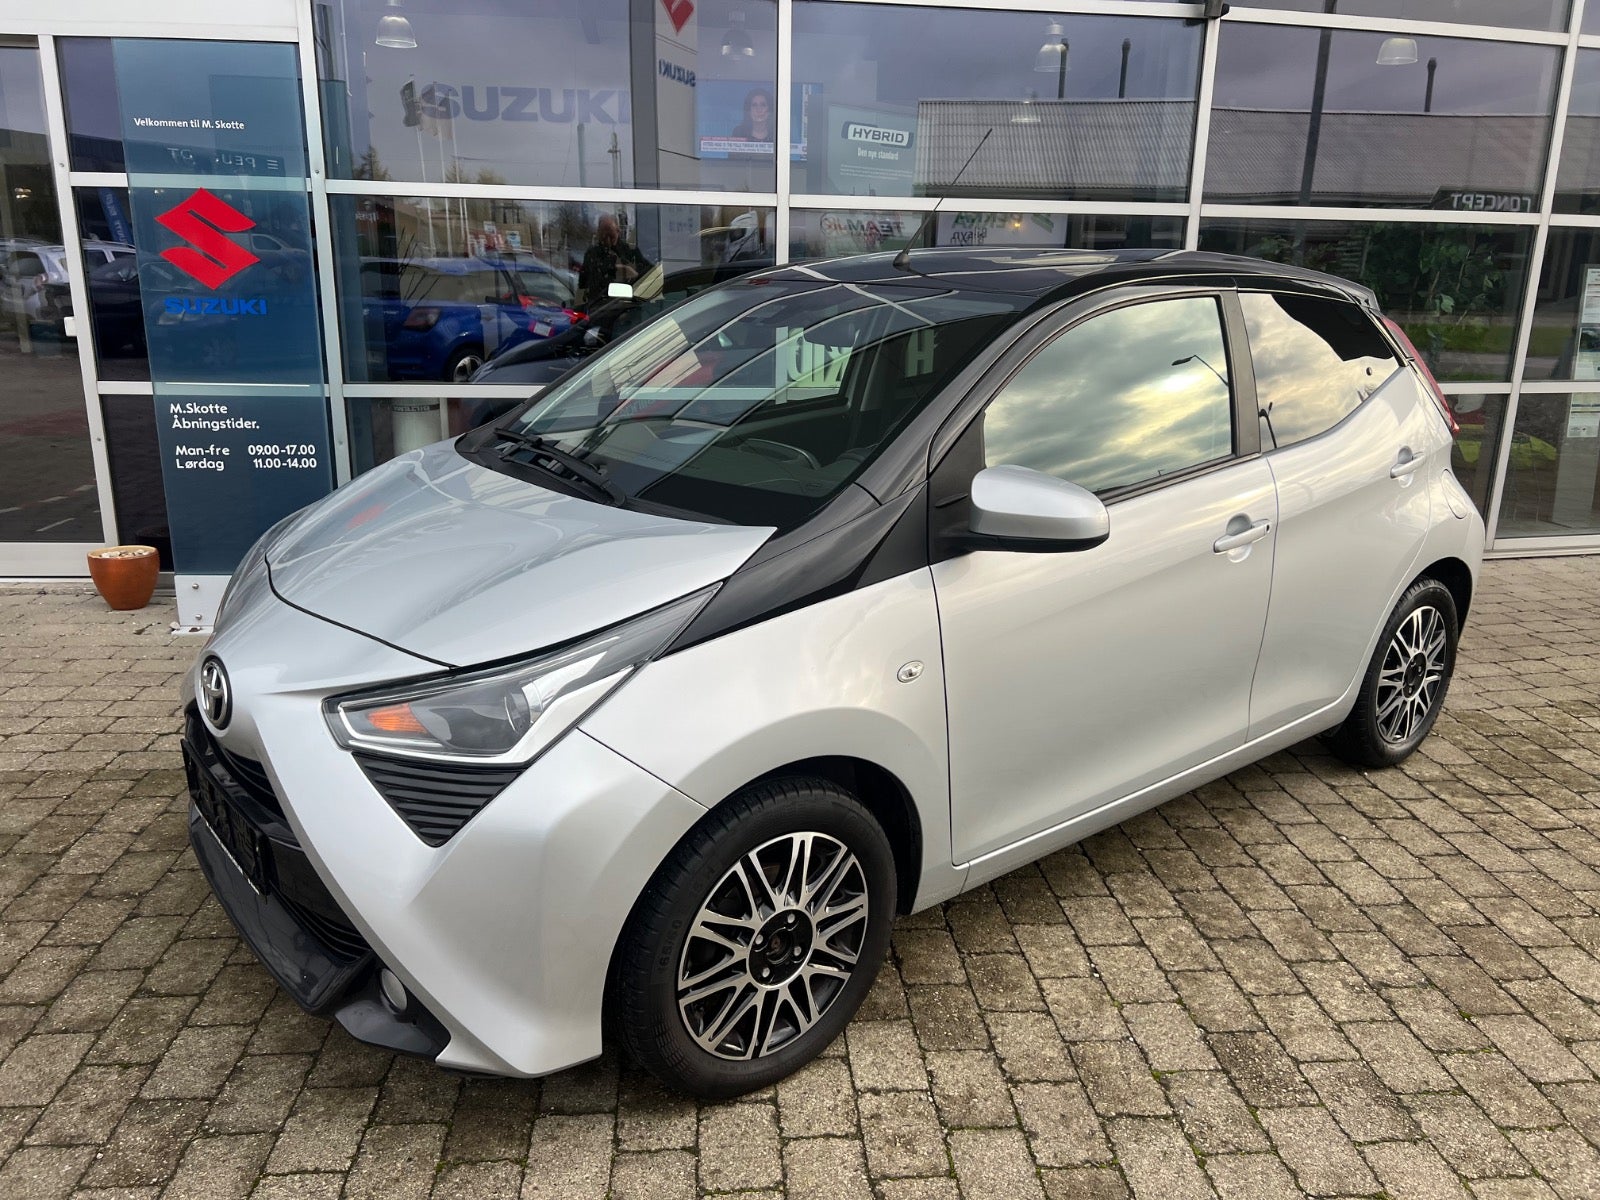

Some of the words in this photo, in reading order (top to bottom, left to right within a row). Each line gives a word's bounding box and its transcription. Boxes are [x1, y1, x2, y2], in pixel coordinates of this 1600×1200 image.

[420, 83, 631, 124] SUZUKI
[133, 117, 188, 128] Velkommen
[190, 119, 200, 128] til
[201, 120, 214, 129] M.
[215, 120, 245, 130] Skotte
[852, 127, 905, 143] HYBRID
[164, 297, 268, 315] SUZUKI
[172, 415, 260, 431] Åbningstider.
[175, 445, 230, 456] Man-fre
[247, 444, 316, 456] 09.00-17.00
[176, 458, 225, 471] Lørdag
[253, 457, 318, 469] 11.00-14.00
